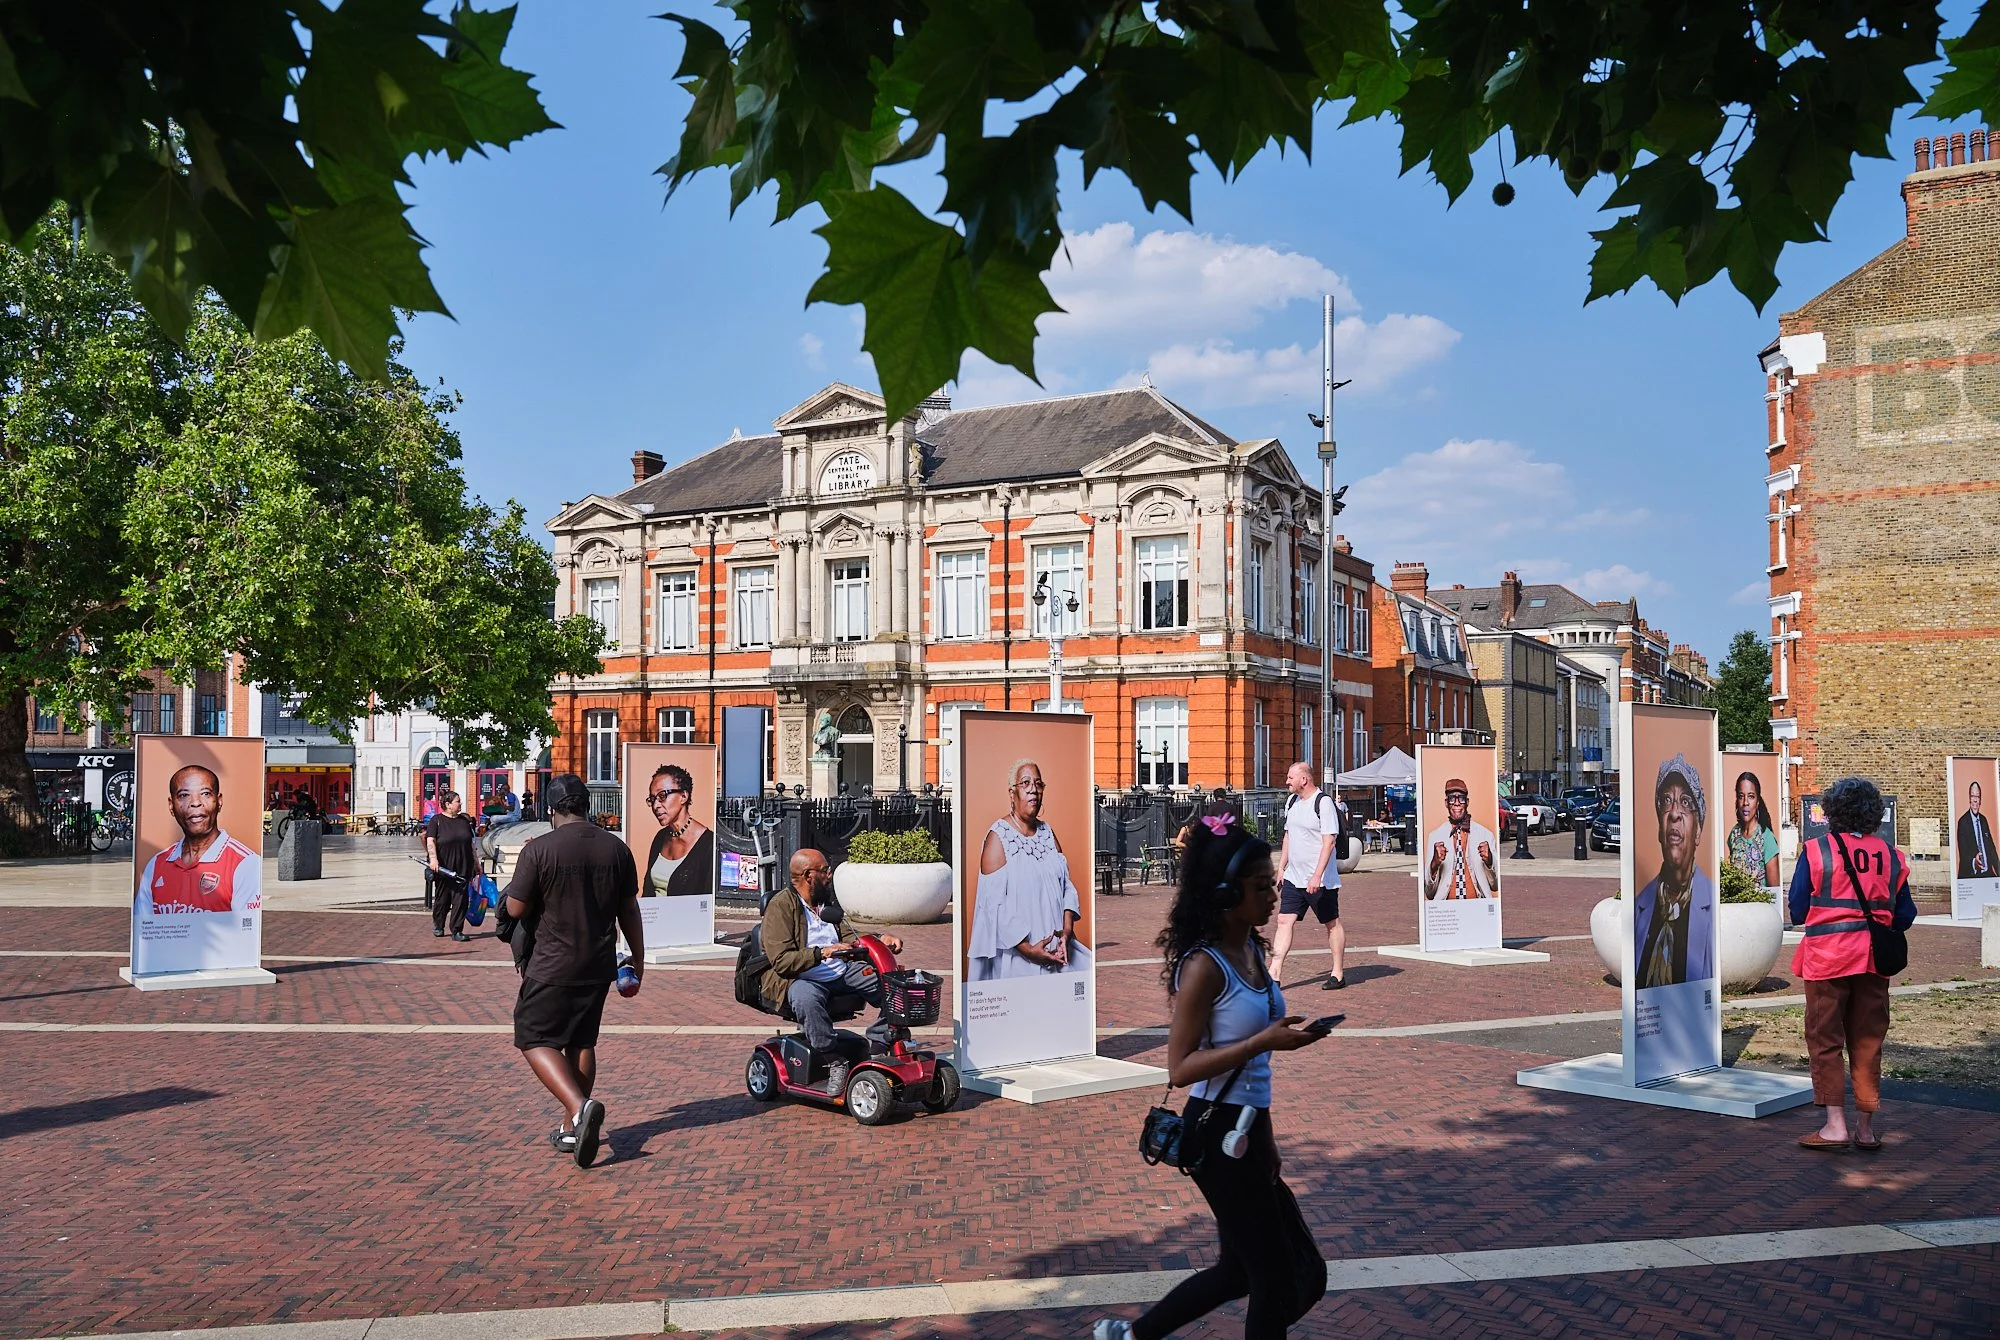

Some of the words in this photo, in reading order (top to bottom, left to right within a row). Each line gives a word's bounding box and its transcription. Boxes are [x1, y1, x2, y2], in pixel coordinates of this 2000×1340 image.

[839, 456, 859, 465] TATE
[828, 480, 869, 491] LIBRARY
[77, 755, 115, 767] KFC
[153, 900, 212, 914] Emirate
